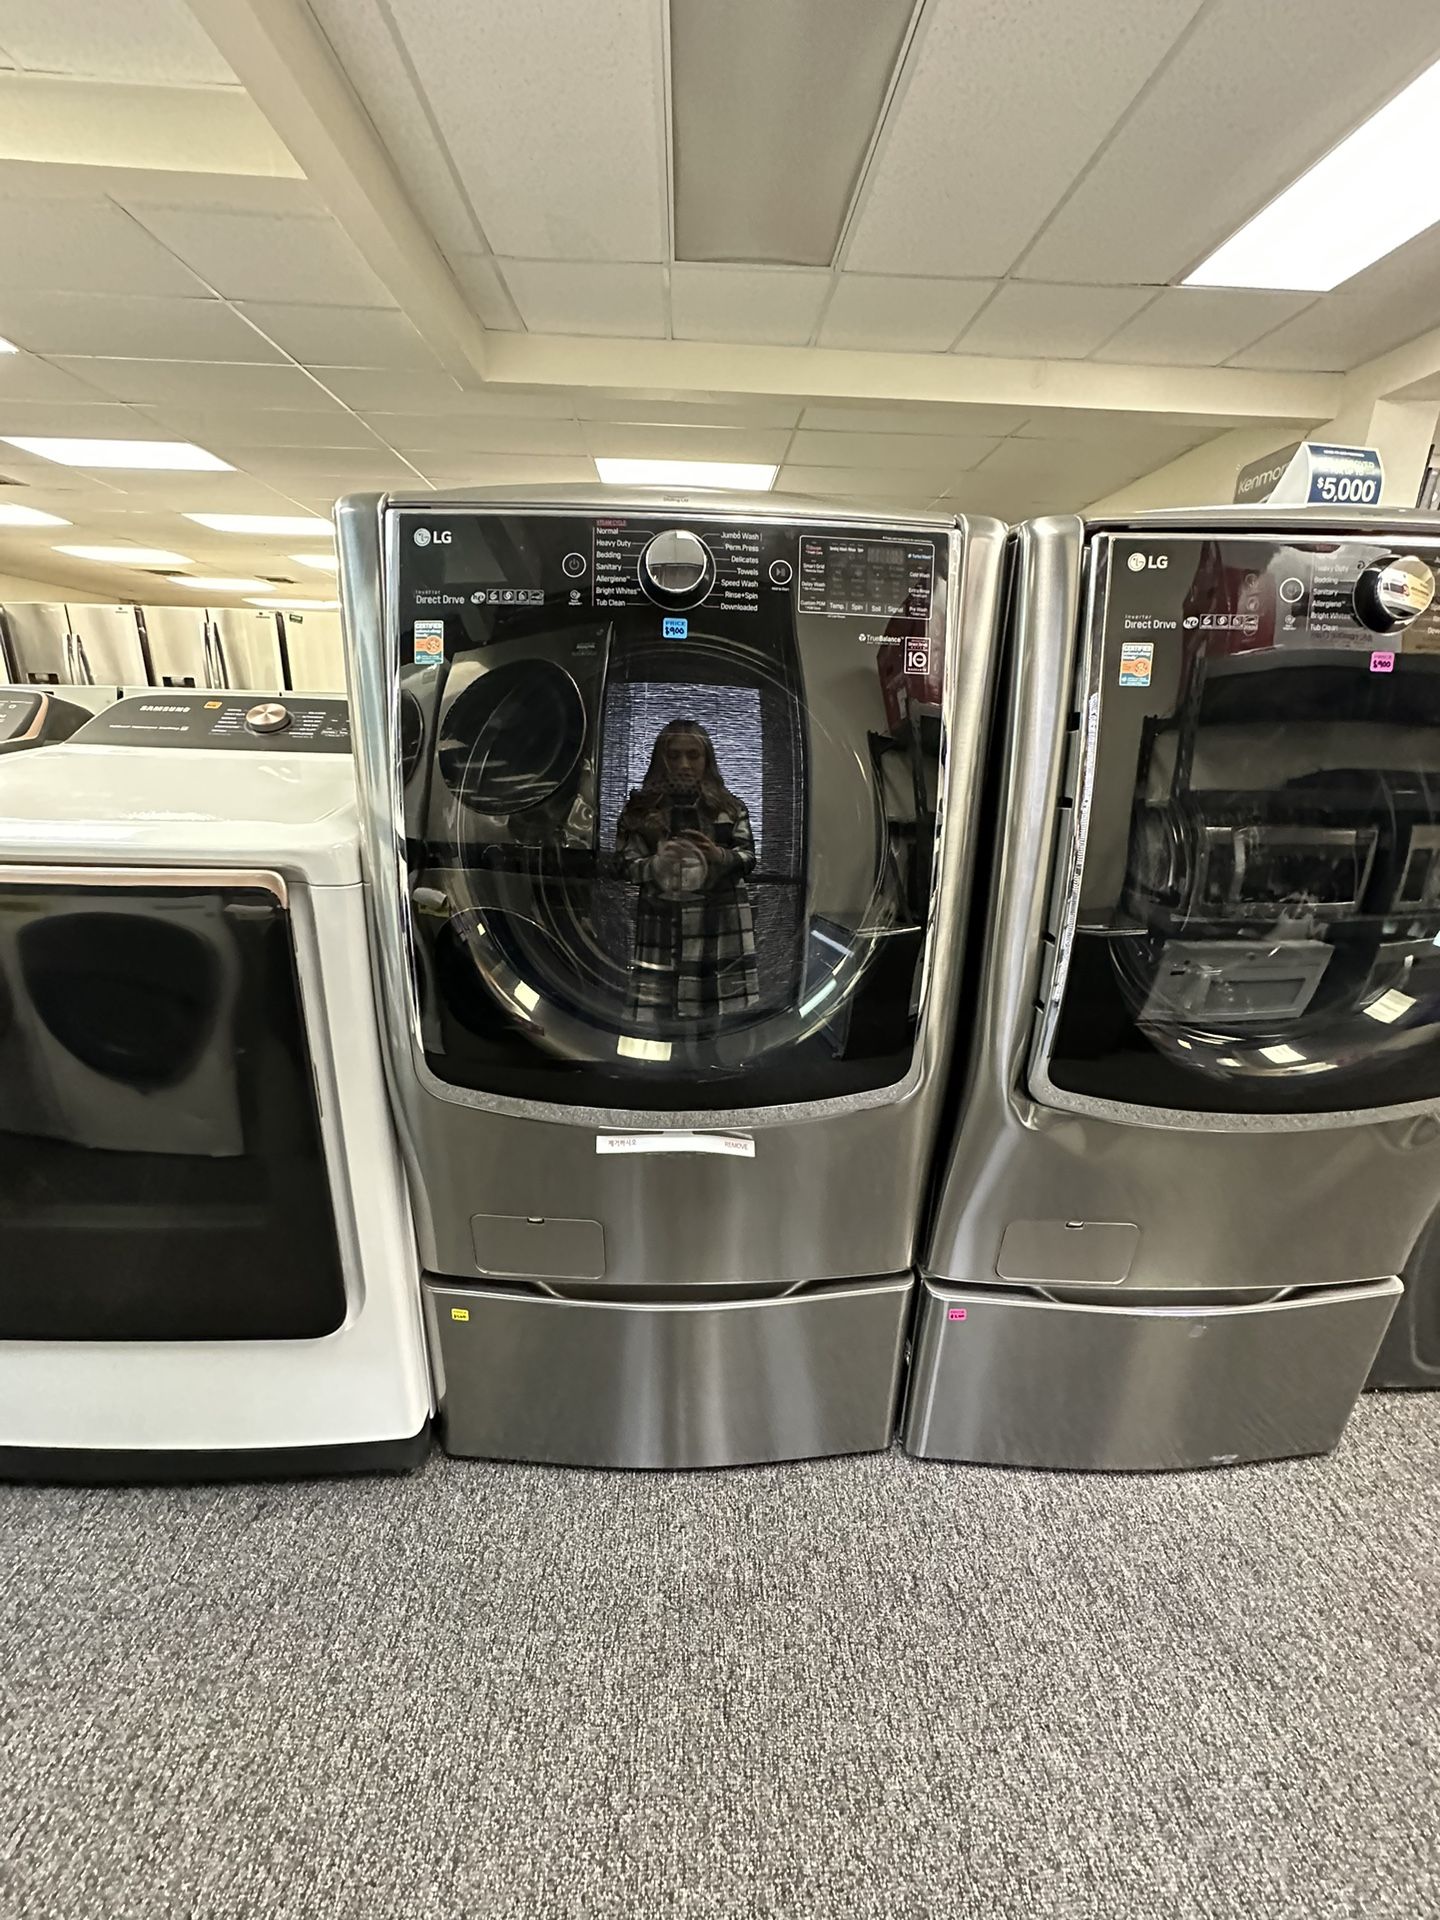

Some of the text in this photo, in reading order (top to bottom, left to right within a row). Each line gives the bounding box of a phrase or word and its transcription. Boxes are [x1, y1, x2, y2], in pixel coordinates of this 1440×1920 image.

[596, 527, 619, 535] Normal
[720, 531, 760, 540] Jumbo Wash
[433, 531, 452, 544] LG
[596, 540, 632, 548] Heavy Duty
[596, 551, 622, 560] Bedding
[731, 555, 759, 564] Delicates
[595, 563, 622, 571] Sanitary
[1148, 556, 1169, 569] LG
[736, 567, 759, 576] Towels
[720, 579, 759, 588] Speed Wash
[1313, 576, 1339, 584] Bedding
[595, 587, 615, 596] Bright
[1312, 588, 1339, 596] Sanitary
[416, 595, 465, 605] Direct Drive
[720, 603, 758, 612] Downloaded
[1310, 611, 1329, 620] Bright
[1124, 620, 1177, 629] Direct Drive
[139, 704, 191, 713] SAMSUNG
[724, 1141, 749, 1151] REMOVE
